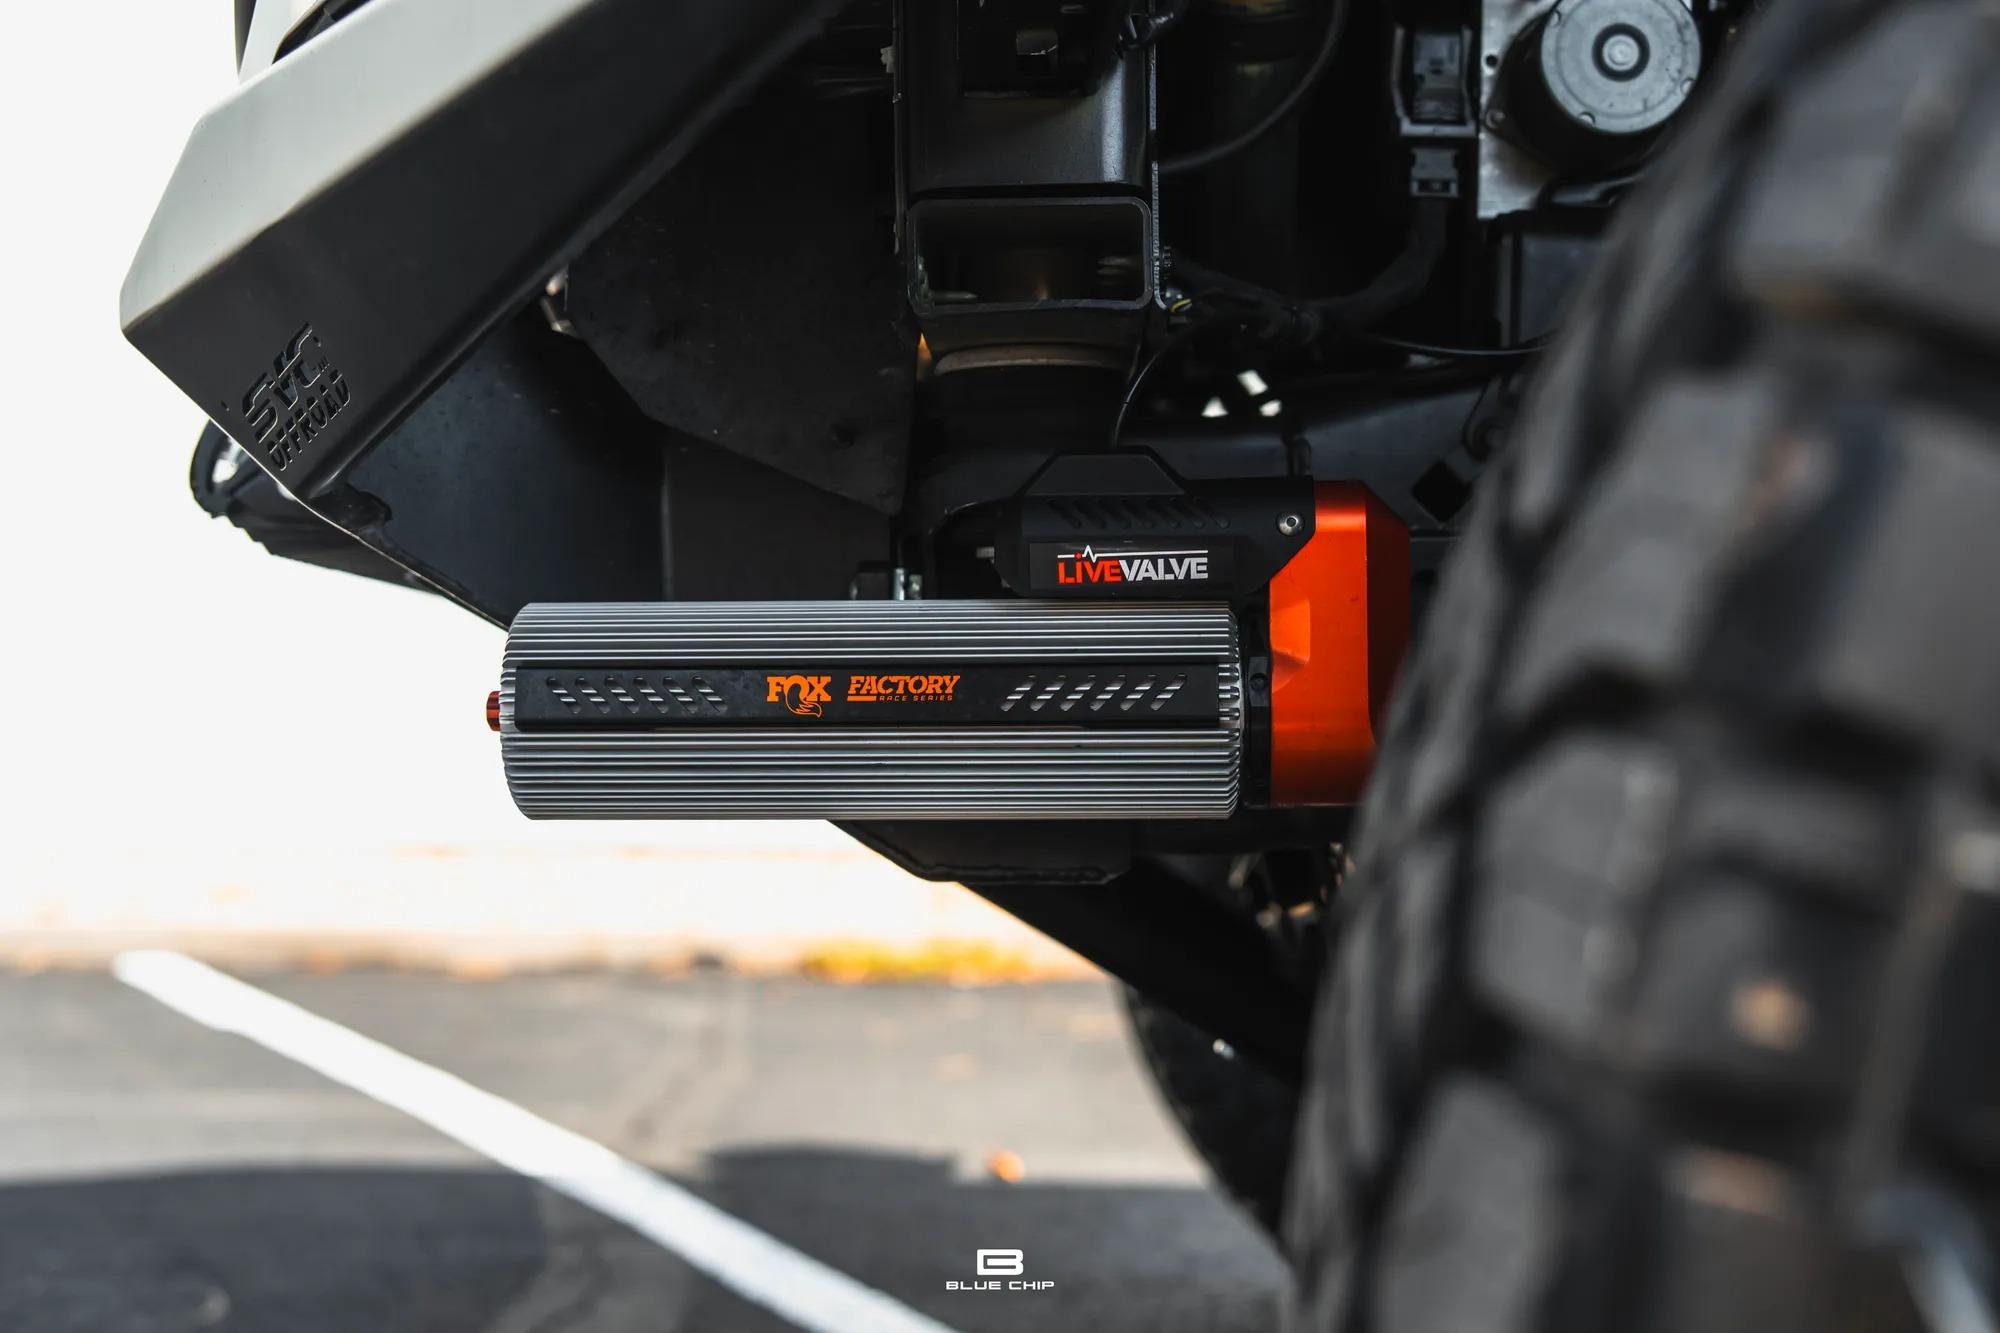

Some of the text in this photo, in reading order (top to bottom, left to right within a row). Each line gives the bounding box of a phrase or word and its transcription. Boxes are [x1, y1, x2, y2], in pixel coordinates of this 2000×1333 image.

[242, 322, 322, 443] SVC
[267, 369, 350, 471] OFFROAD
[766, 675, 960, 717] FOX FACTORY
